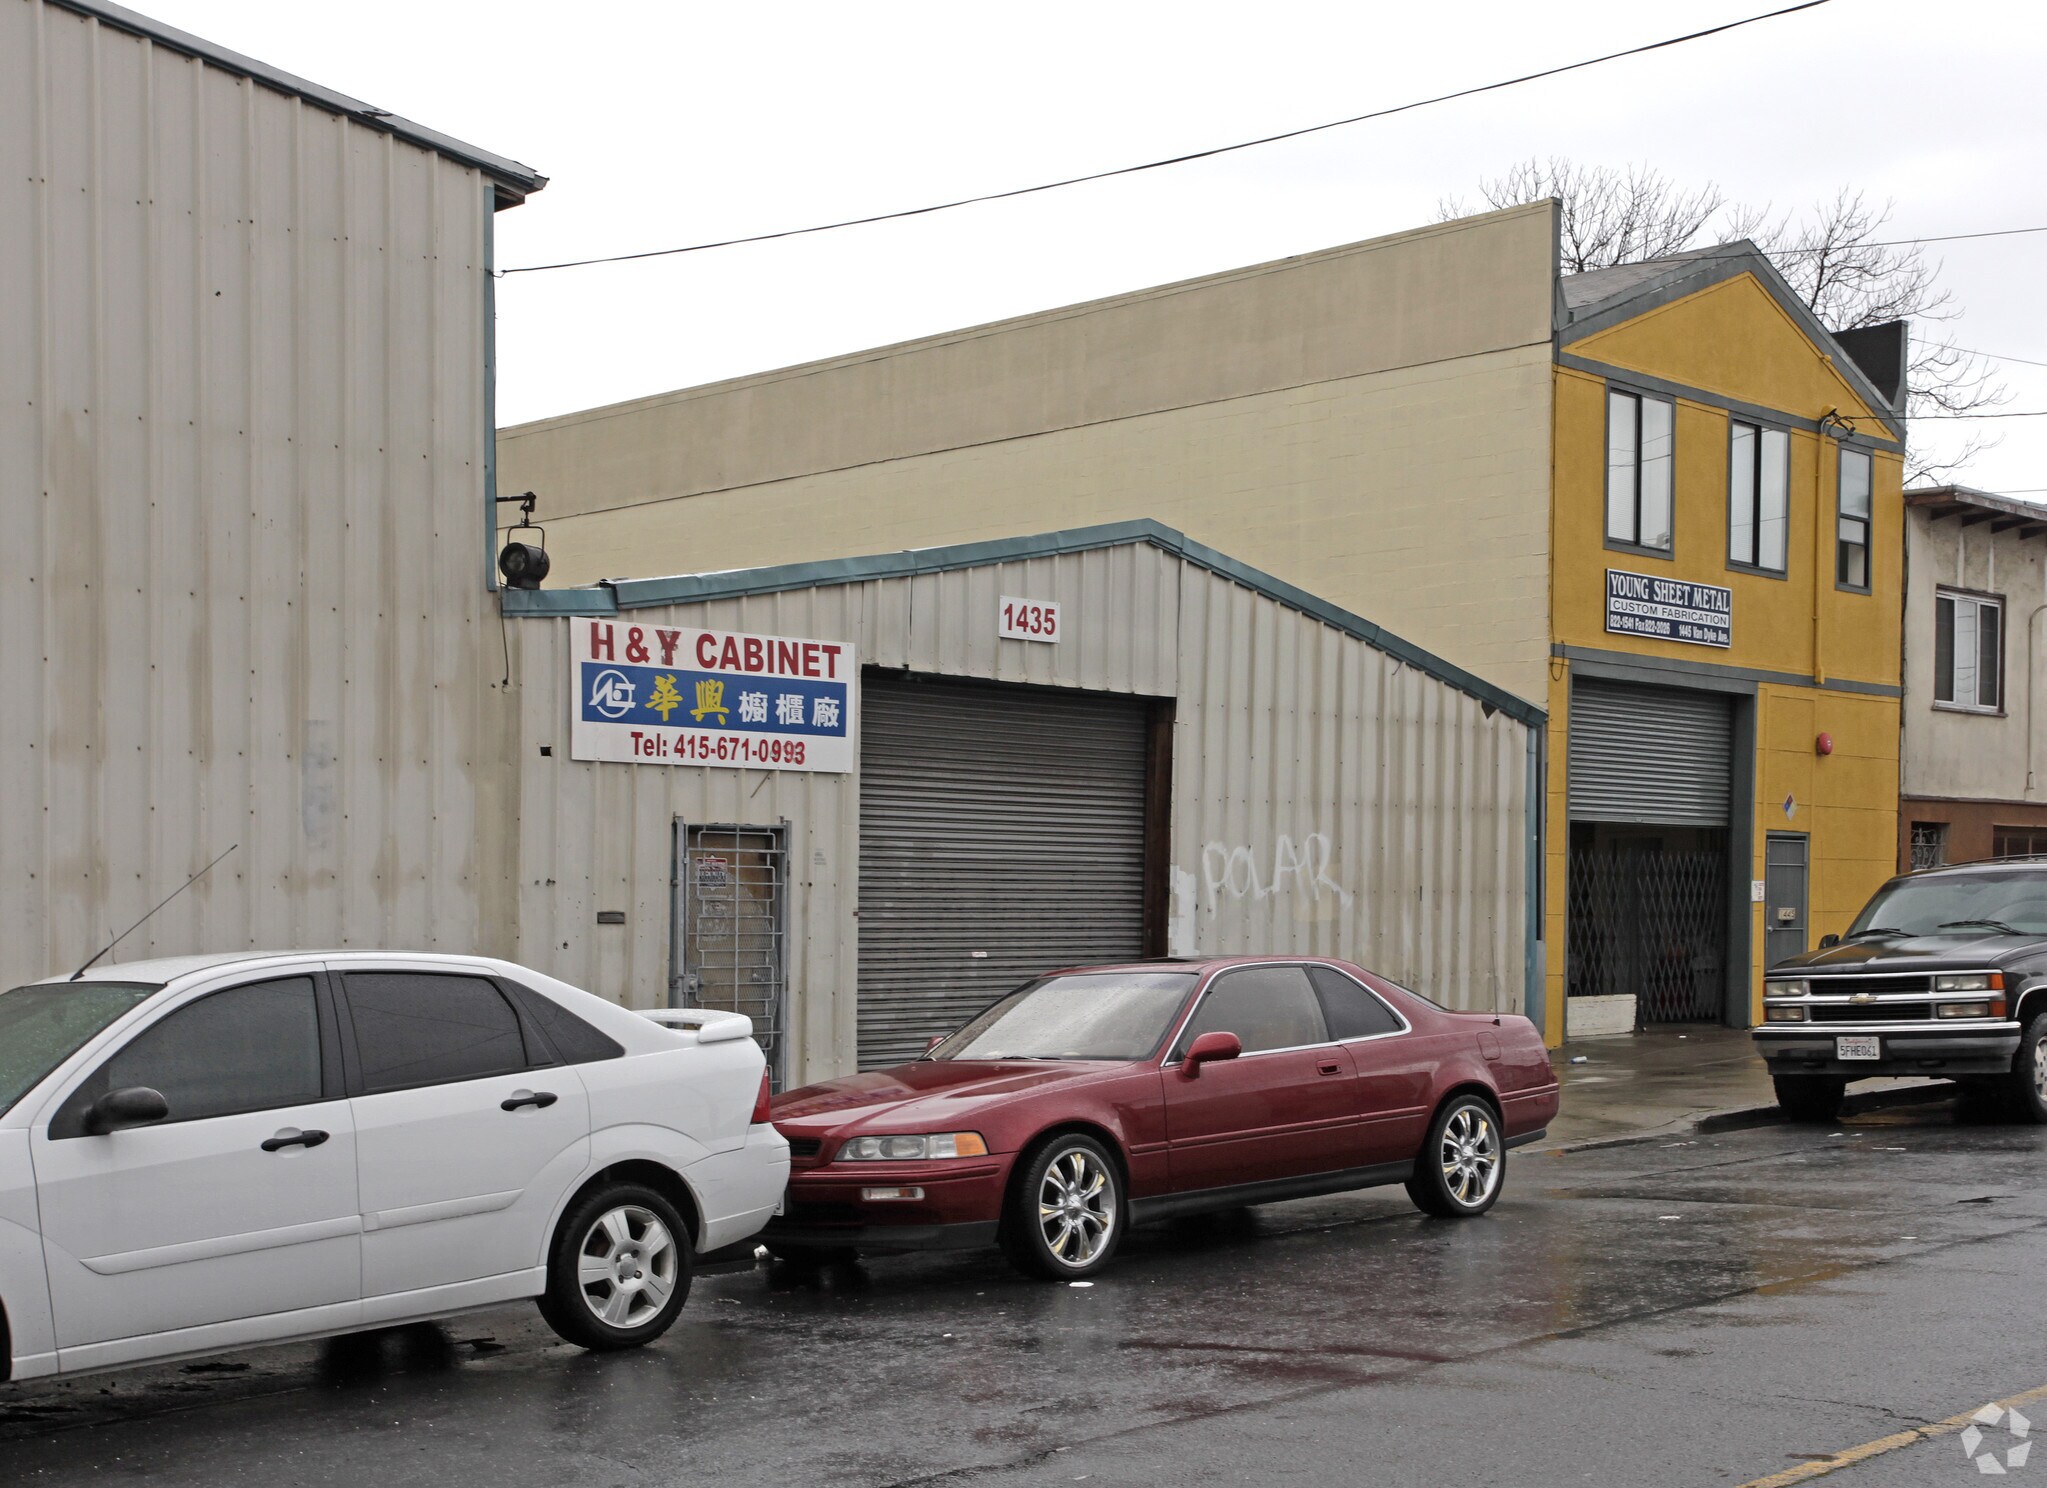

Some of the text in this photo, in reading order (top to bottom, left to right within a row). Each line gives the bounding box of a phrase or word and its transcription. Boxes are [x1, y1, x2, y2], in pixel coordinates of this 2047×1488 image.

[1610, 573, 1729, 612] YOUNG SHEET METAL
[1004, 603, 1055, 635] 1435
[1613, 600, 1727, 626] CUSTOM FABRICATION
[1692, 626, 1703, 640] Van
[1704, 628, 1717, 643] Dyke
[696, 633, 841, 678] CABINET
[631, 731, 806, 765] Tel: 415-671-0993
[1202, 833, 1354, 921] POLAR
